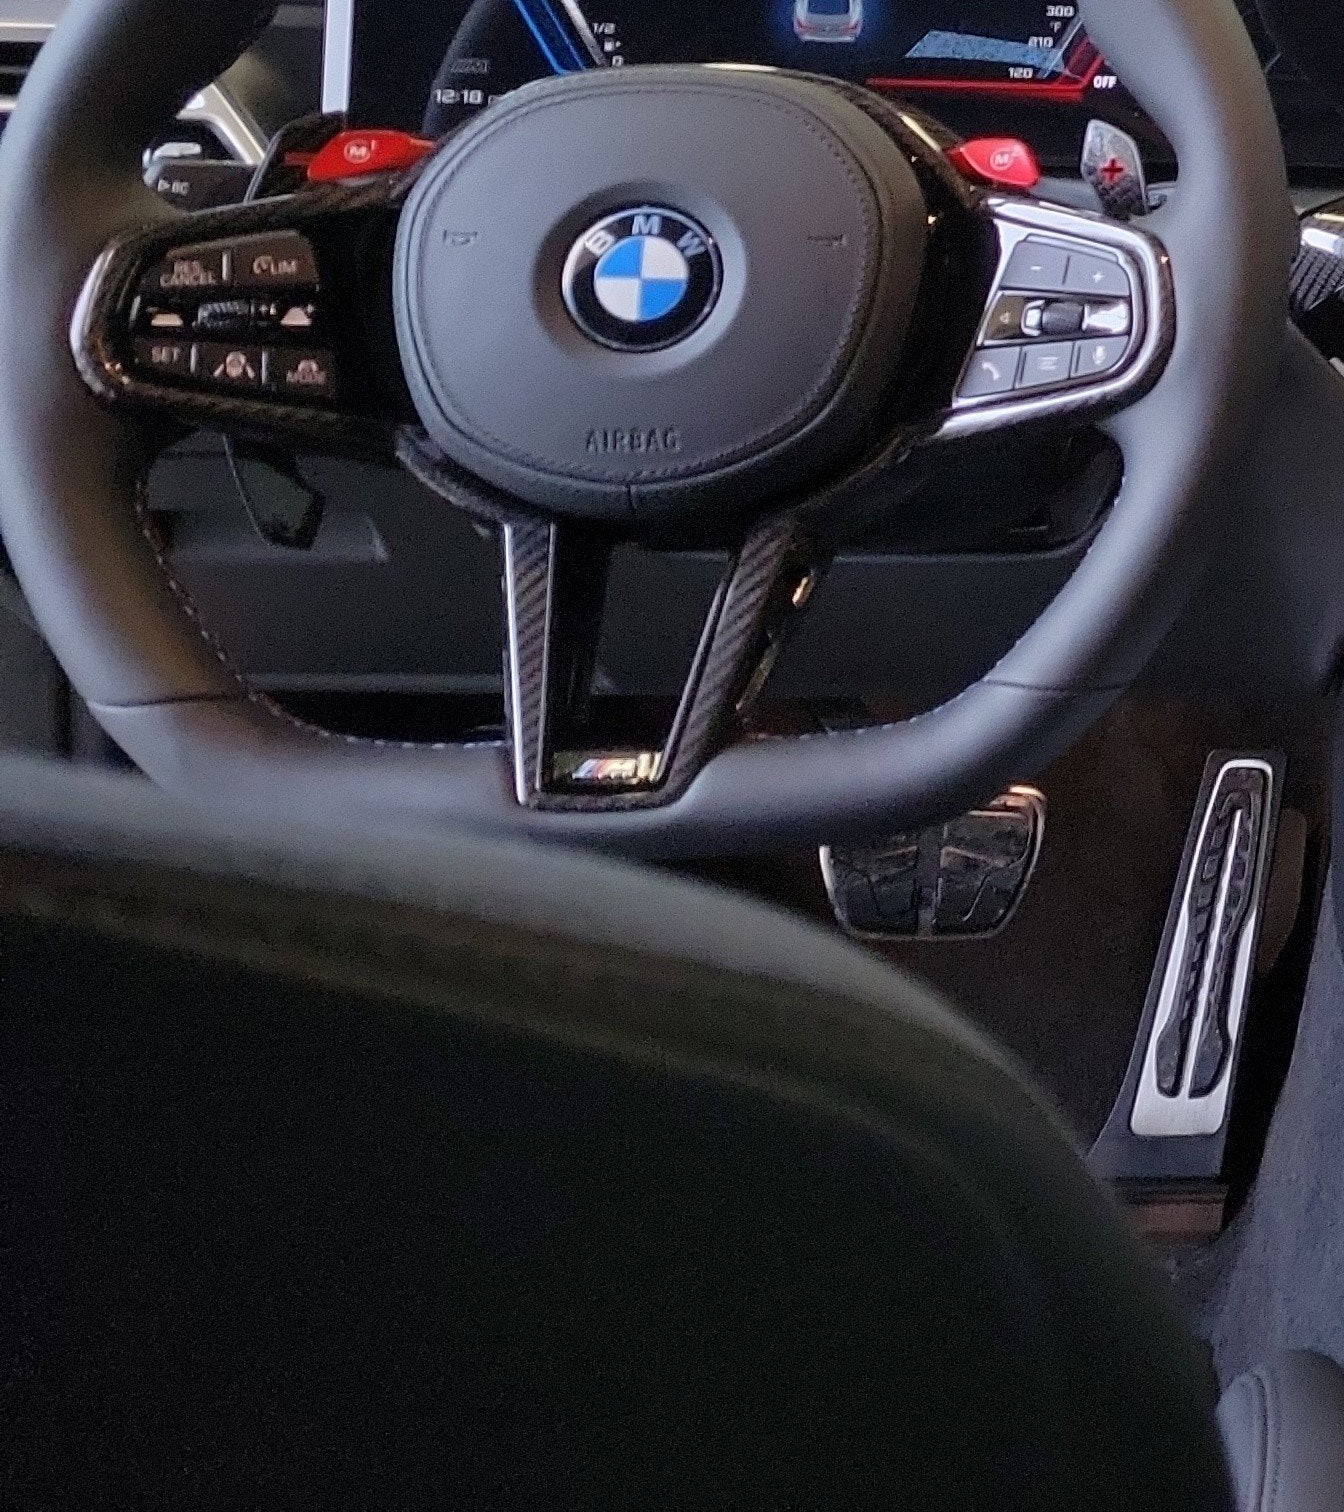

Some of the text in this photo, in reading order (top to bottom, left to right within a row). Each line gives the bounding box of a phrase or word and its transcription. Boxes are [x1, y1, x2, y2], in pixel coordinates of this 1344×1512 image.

[1093, 75, 1118, 89] OFF
[584, 214, 707, 257] BMW
[585, 426, 683, 454] AIRBAG
